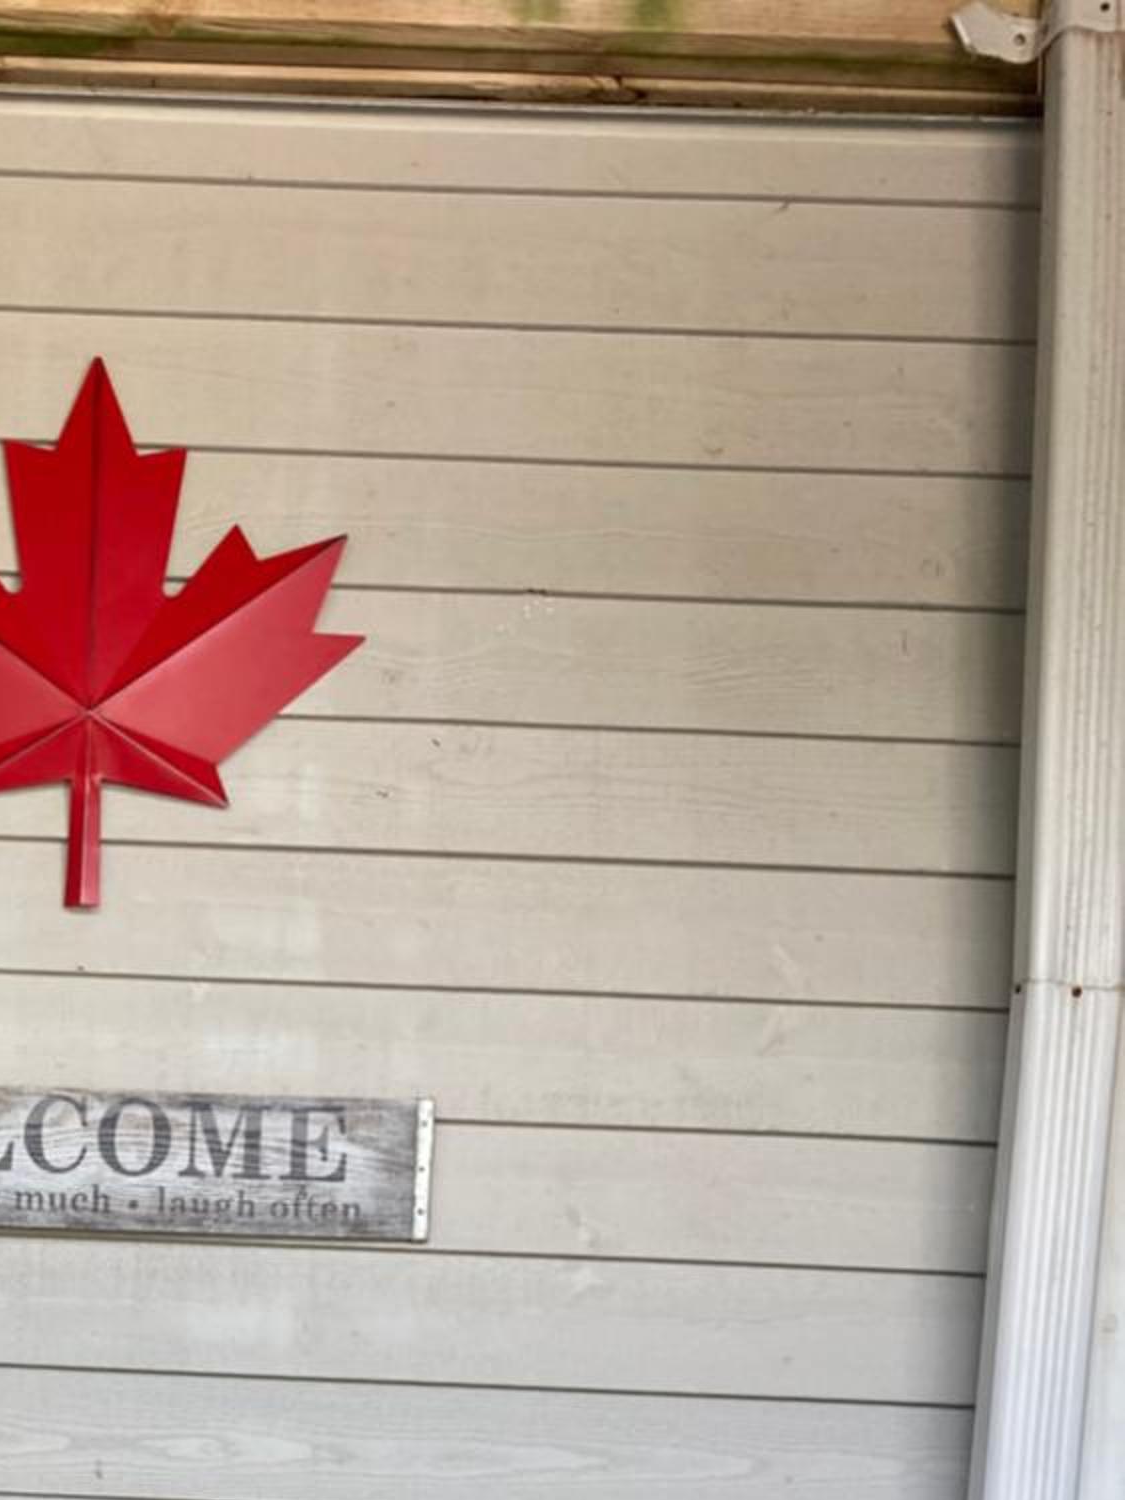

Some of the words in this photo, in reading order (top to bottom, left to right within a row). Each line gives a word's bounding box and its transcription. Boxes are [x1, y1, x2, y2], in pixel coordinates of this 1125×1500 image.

[14, 1184, 111, 1215] much
[157, 1186, 256, 1226] laugh
[269, 1184, 361, 1220] often
